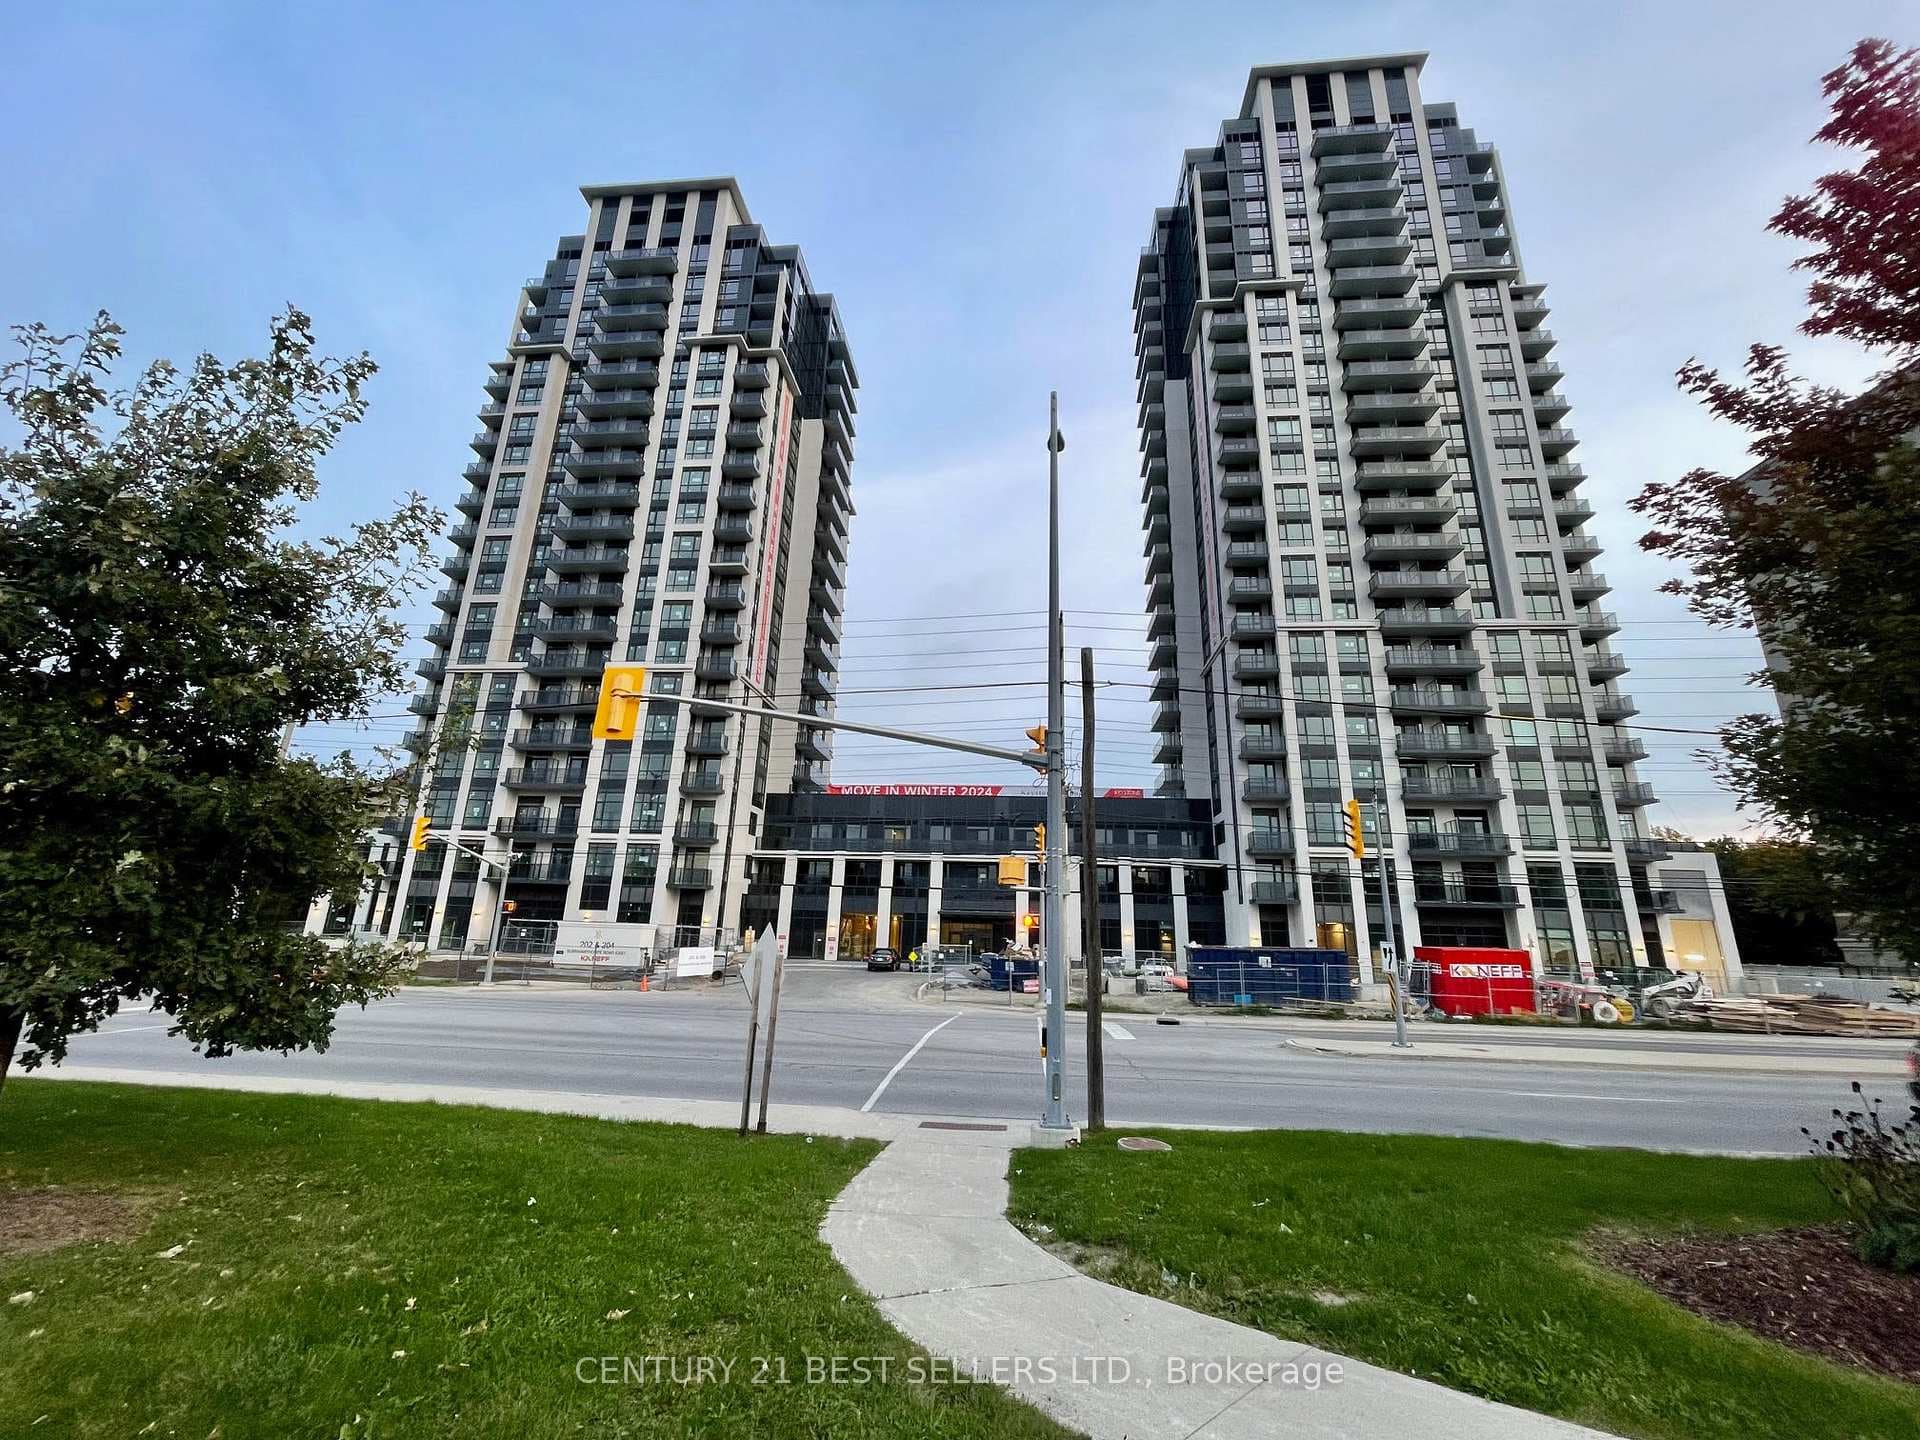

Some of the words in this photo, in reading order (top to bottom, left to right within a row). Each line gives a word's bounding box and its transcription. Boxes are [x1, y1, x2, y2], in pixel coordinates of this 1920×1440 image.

[841, 786, 880, 795] MOVE
[885, 786, 899, 795] IN
[904, 786, 956, 796] WINTER
[960, 787, 992, 796] 2024
